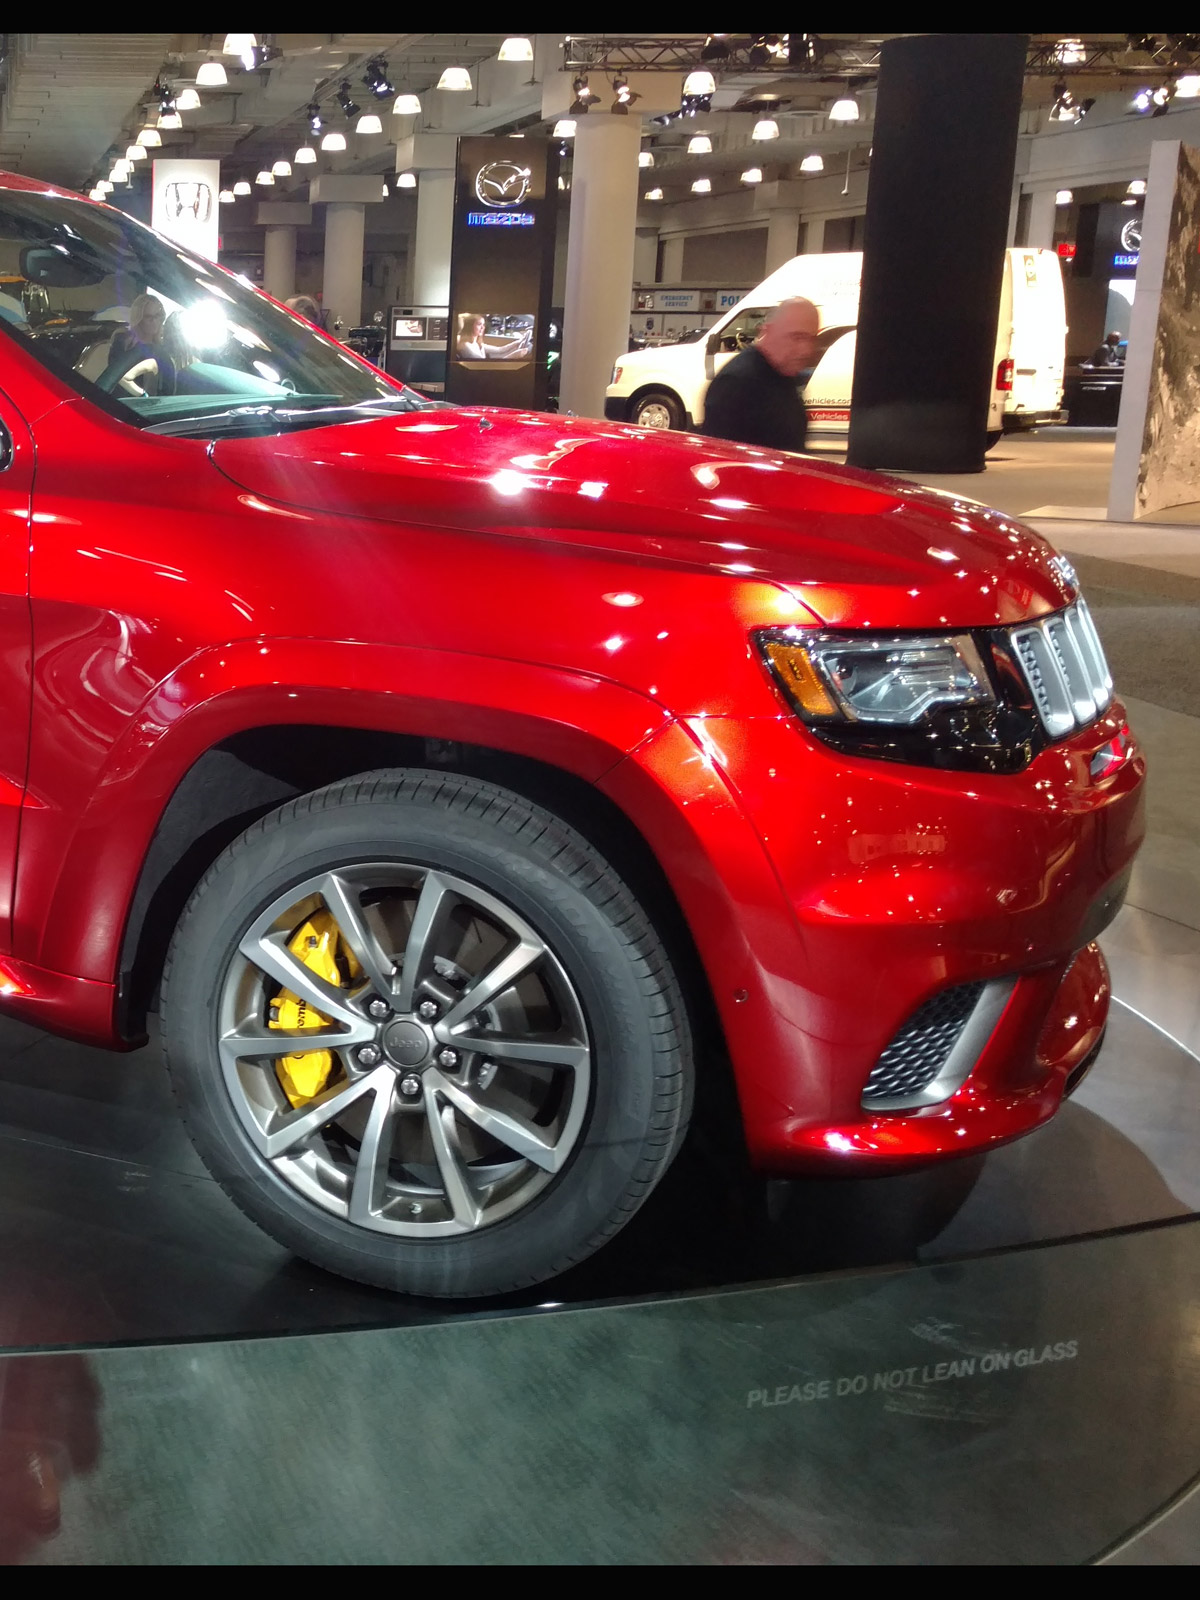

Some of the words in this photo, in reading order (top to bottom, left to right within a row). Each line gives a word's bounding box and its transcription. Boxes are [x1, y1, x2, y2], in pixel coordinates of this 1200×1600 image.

[810, 412, 849, 421] Vehicles
[747, 1380, 830, 1408] PLEASE
[836, 1374, 868, 1397] DO
[873, 1366, 919, 1391] NOT
[922, 1359, 975, 1384] LEAN
[980, 1351, 1012, 1374] ON
[1014, 1340, 1080, 1368] GLASS
